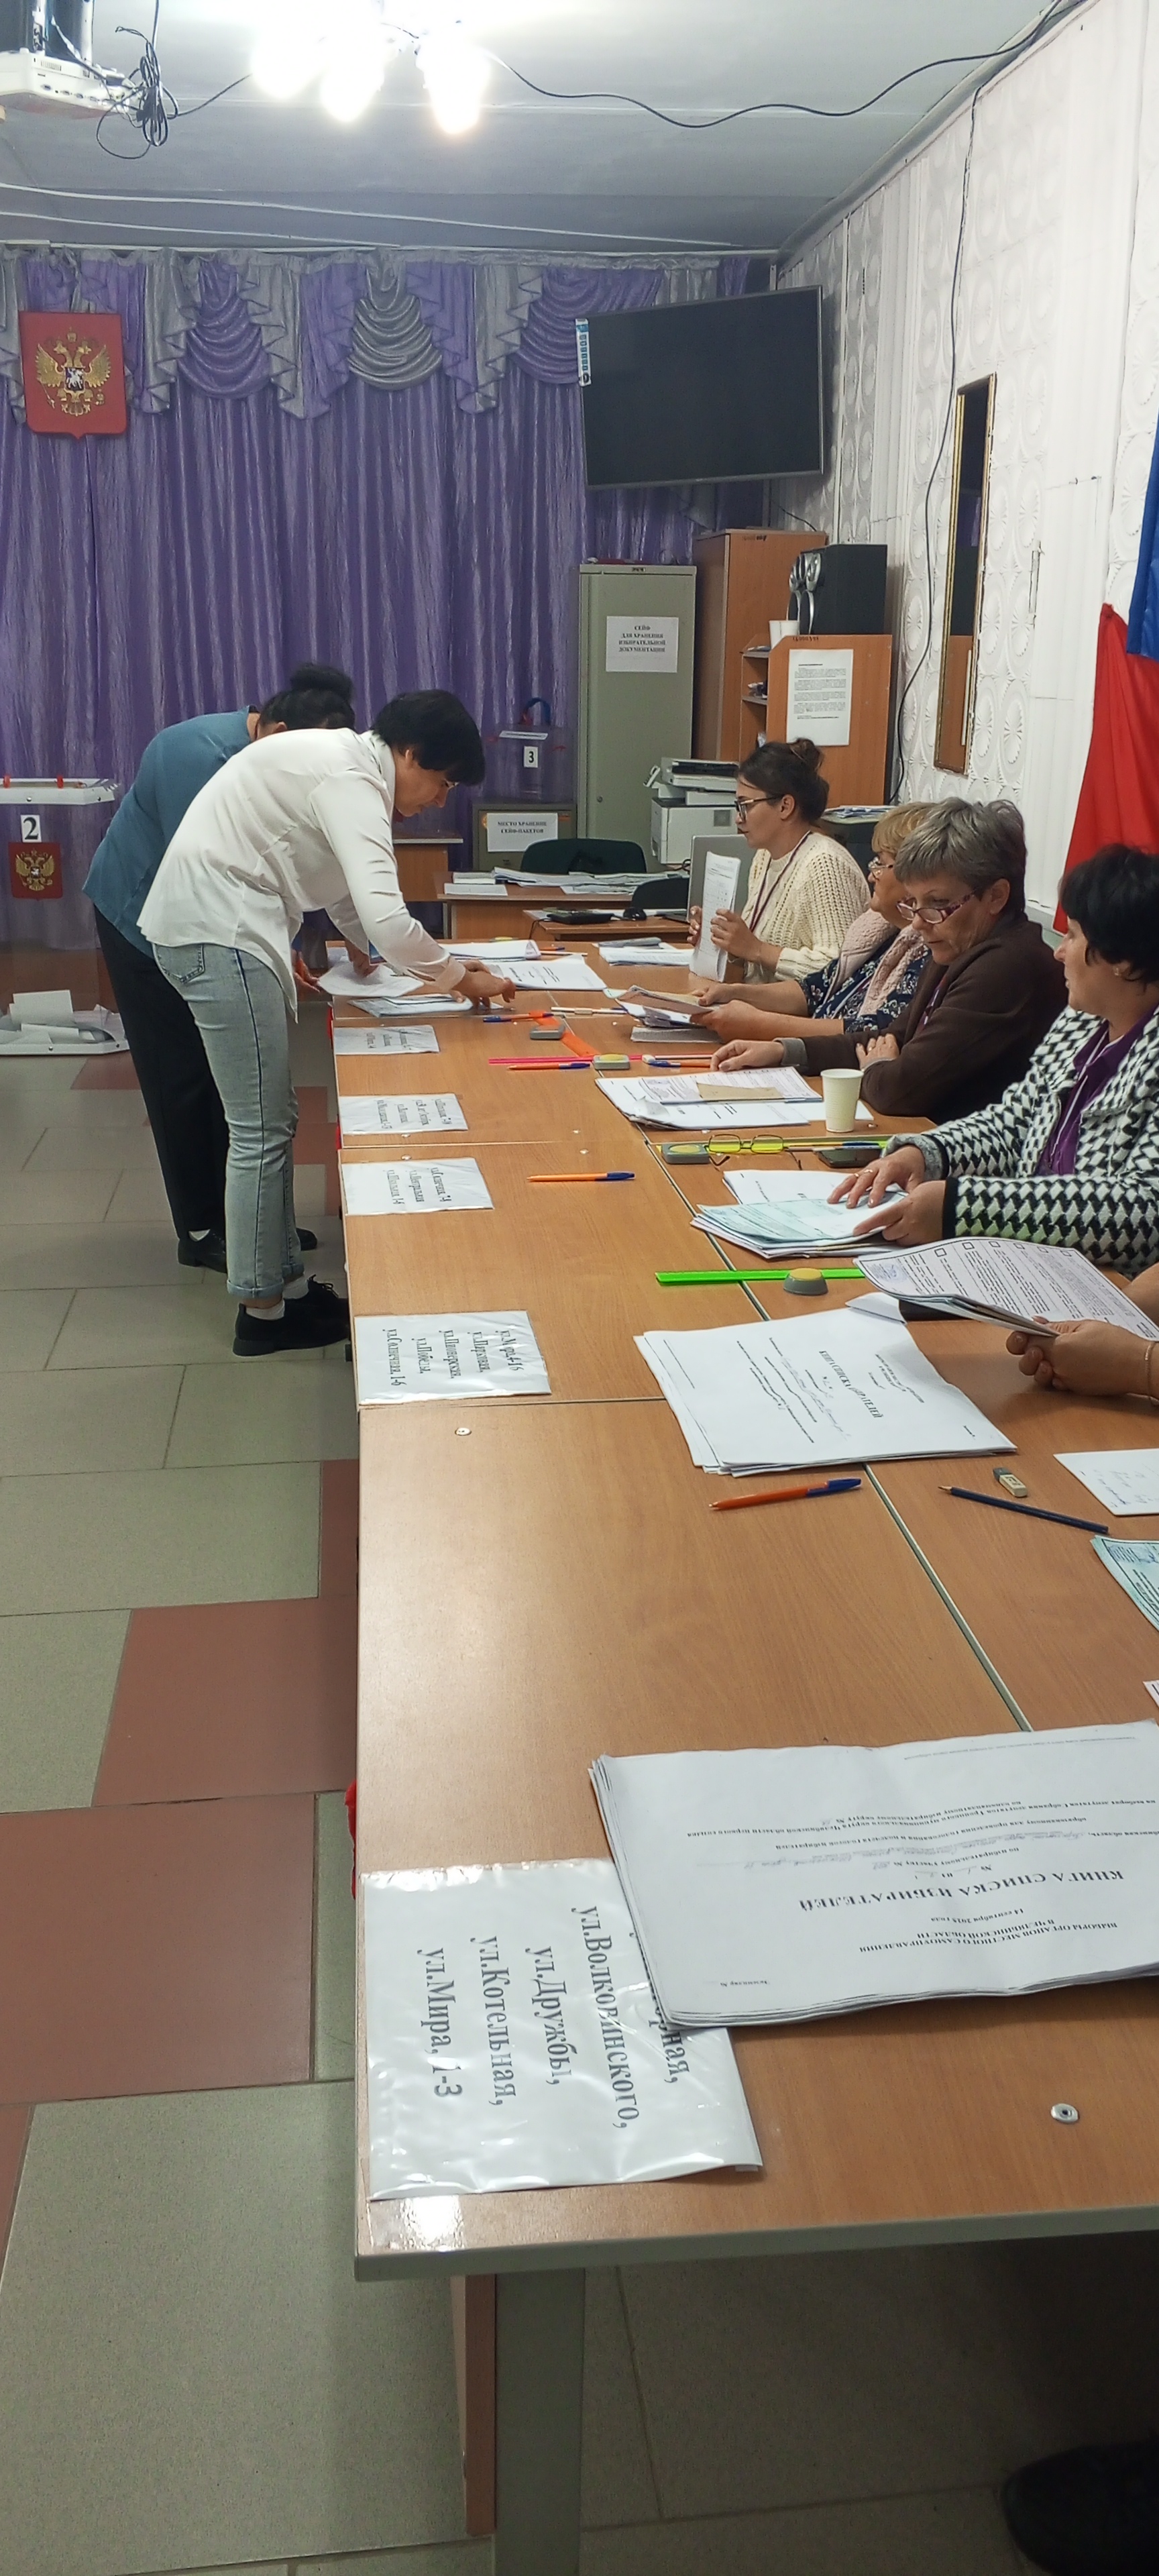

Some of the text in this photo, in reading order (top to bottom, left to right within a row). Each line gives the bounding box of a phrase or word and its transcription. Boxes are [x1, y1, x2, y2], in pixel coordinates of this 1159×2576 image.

[528, 751, 535, 763] 3
[23, 816, 39, 840] 2
[799, 1870, 1124, 1911] КНИГА СПИСКА ИЗБИРАТЕЛЕЙ
[973, 1911, 1012, 1922] сентября
[962, 1933, 1021, 1945] МЕСТНОГО
[968, 1921, 1046, 1938] ЧЕЛЯБИНСКОЙ
[1022, 1925, 1070, 1936] ОРГАНОВ
[859, 1938, 960, 1952] САМОУПРАВЛЕНИЯ
[417, 1947, 456, 2055] ул.Мира,
[470, 1935, 516, 2106] ул.Котельная,
[525, 1946, 578, 2086] ул.Дружбы,
[571, 1906, 640, 2129] ул.Волковинского,
